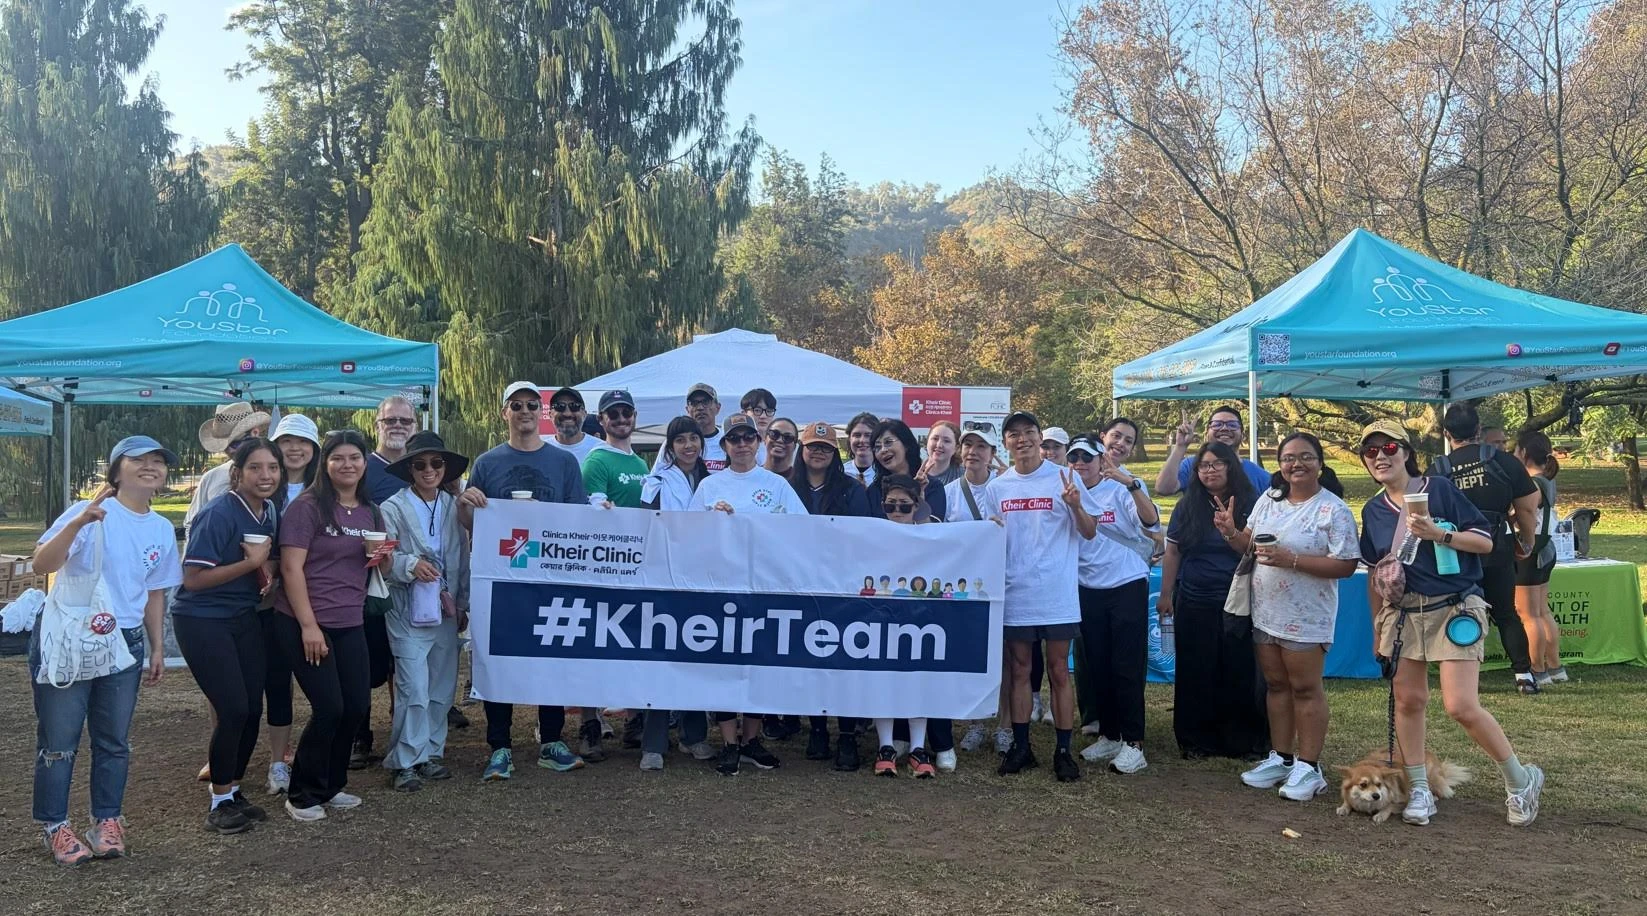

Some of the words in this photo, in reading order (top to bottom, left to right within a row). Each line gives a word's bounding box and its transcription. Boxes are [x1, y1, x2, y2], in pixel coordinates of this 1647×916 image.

[1366, 304, 1495, 318] YouStar
[157, 316, 289, 336] YouStar
[1304, 350, 1397, 360] youstarfoundation.org
[356, 365, 431, 373] @YouStarFoundation
[1455, 474, 1489, 490] DEPT.
[1002, 500, 1025, 511] Kheir
[1027, 498, 1052, 509] Clinic
[1099, 512, 1114, 522] nic
[541, 542, 590, 561] Kheir
[592, 545, 643, 564] Clinic
[1547, 591, 1591, 599] COUNTY
[1570, 601, 1590, 612] OF
[1554, 613, 1589, 625] ALTH
[532, 596, 947, 661] #KheirTeam
[1559, 628, 1589, 638] being.
